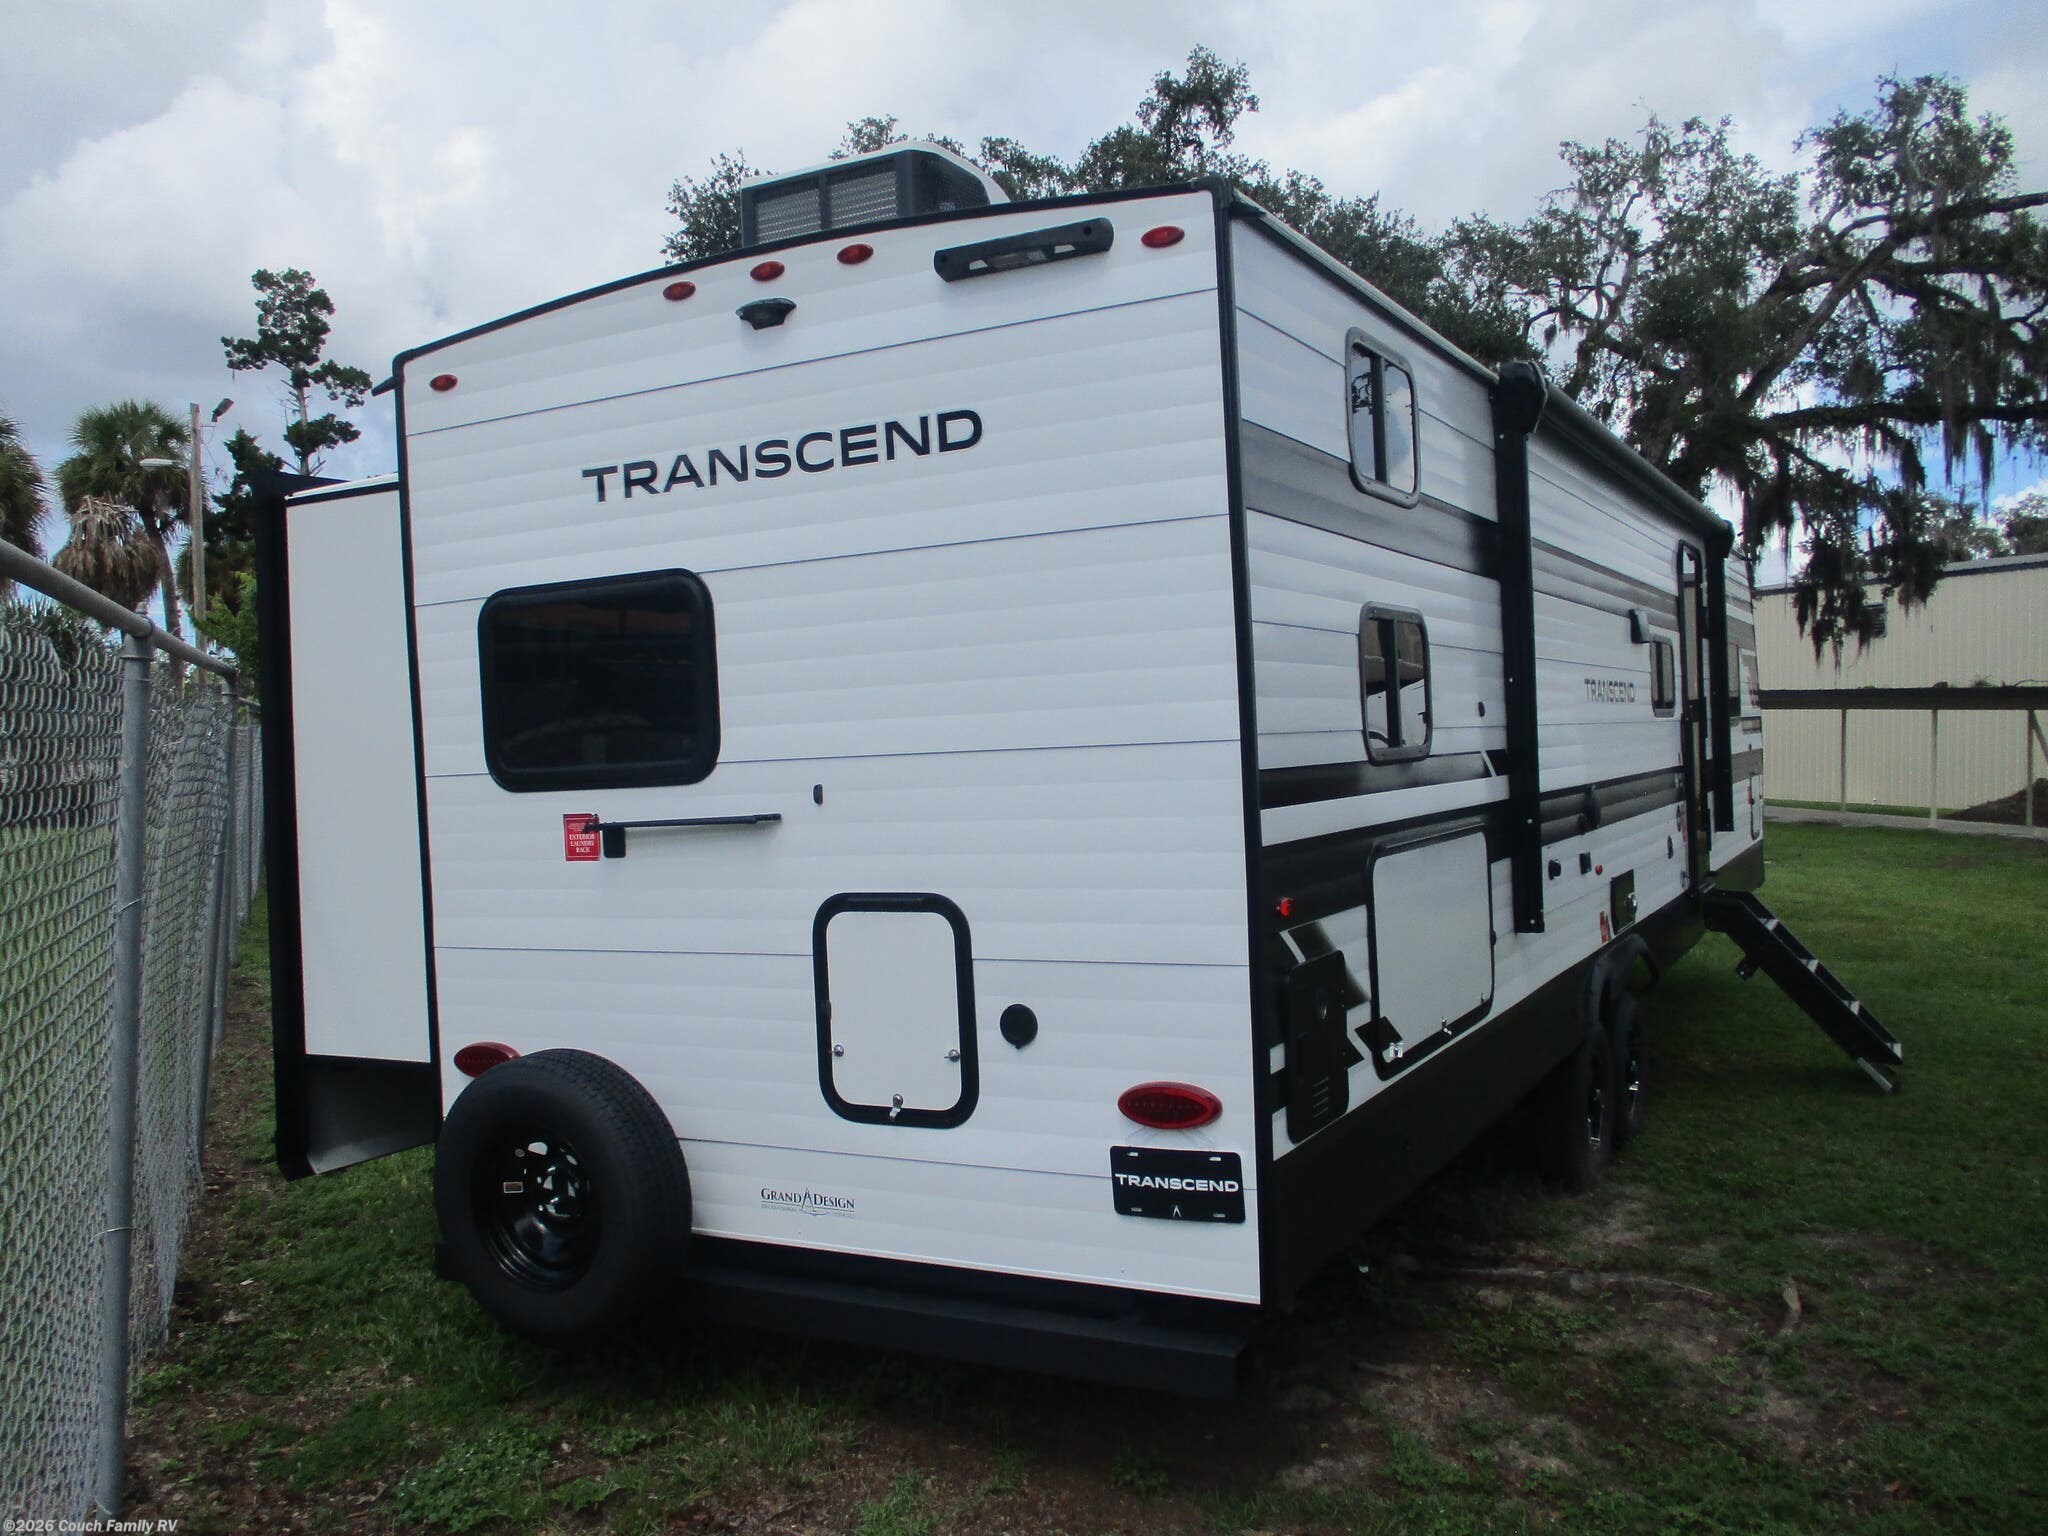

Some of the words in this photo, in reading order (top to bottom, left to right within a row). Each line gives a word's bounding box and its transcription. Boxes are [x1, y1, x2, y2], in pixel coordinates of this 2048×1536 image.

[581, 408, 984, 503] TRANSCEND
[1584, 678, 1635, 703] TRANSCEND
[1114, 1173, 1239, 1193] TRANSCEND
